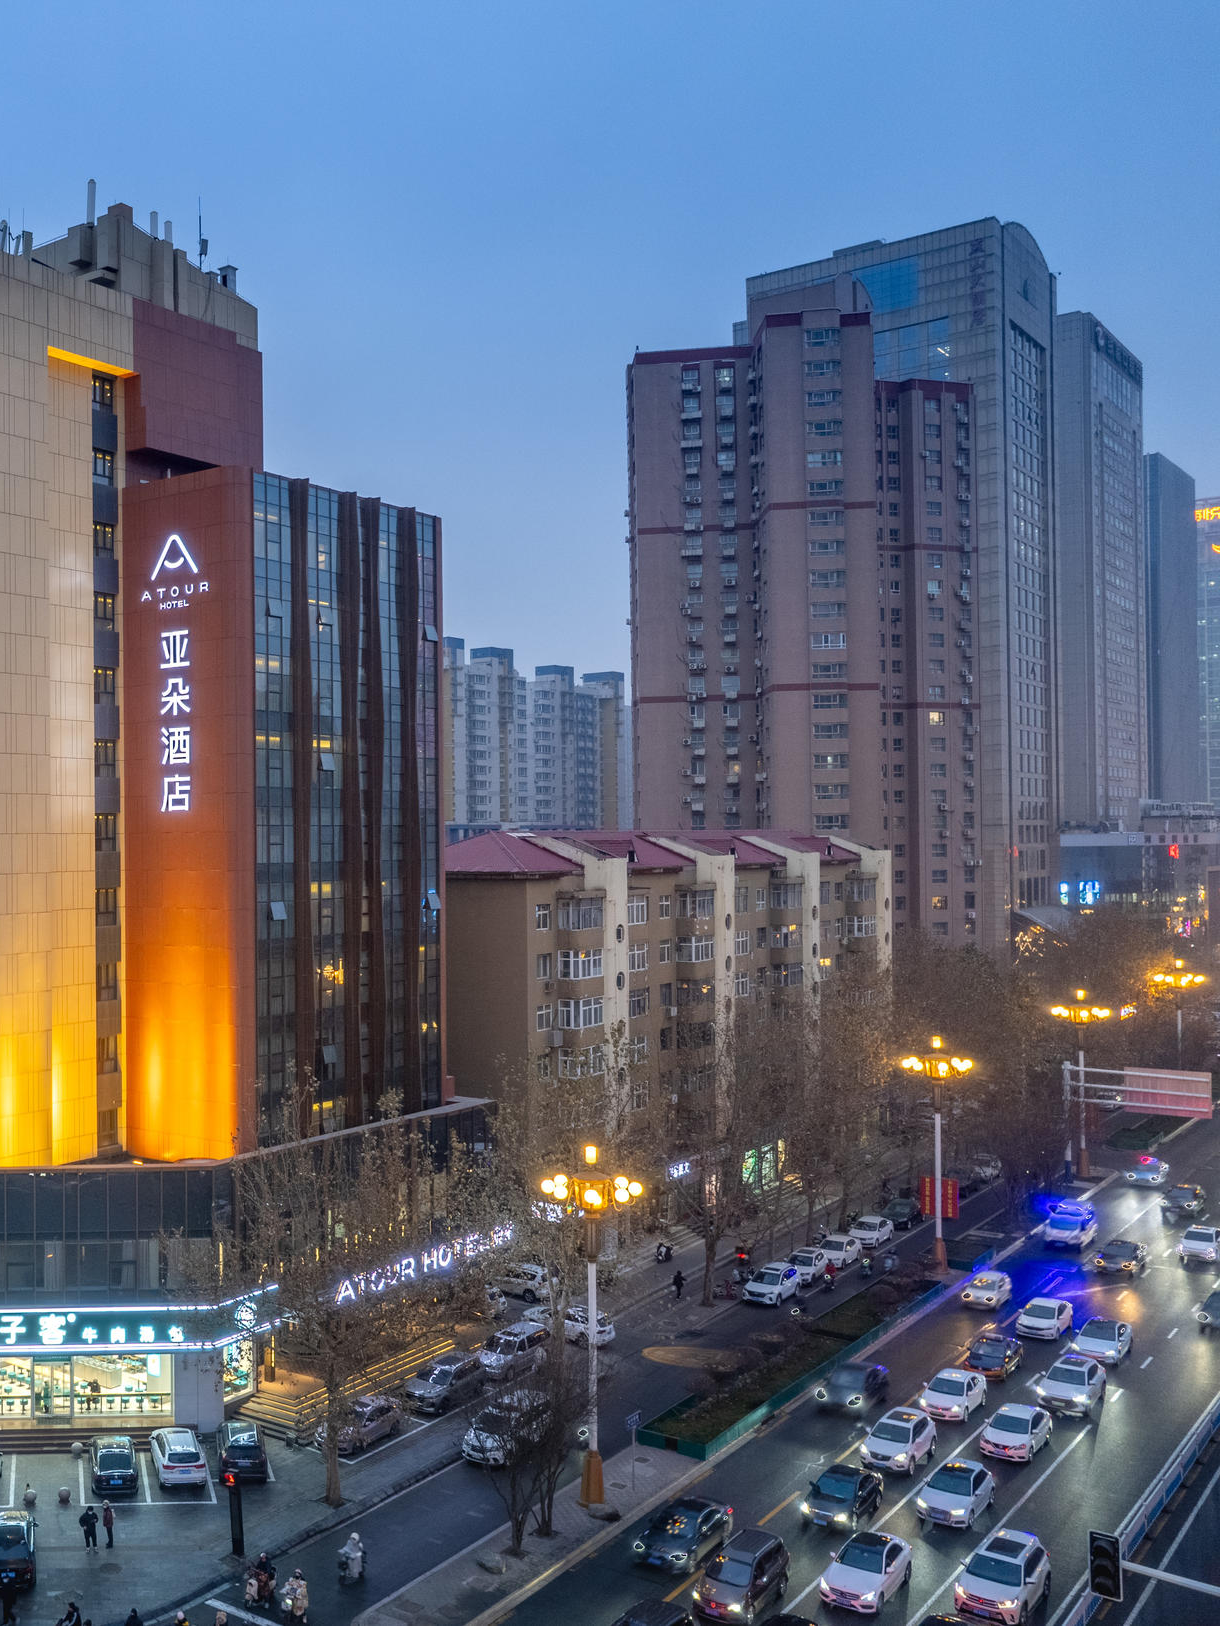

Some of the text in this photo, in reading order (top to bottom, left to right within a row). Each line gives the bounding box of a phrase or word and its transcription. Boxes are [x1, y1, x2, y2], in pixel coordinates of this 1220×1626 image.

[141, 581, 210, 602] ATOUR
[159, 599, 190, 610] HOTEL
[159, 629, 191, 813] 亚朵酒店
[335, 1257, 416, 1305] ATOUR
[81, 1325, 185, 1344] 牛肉汤包
